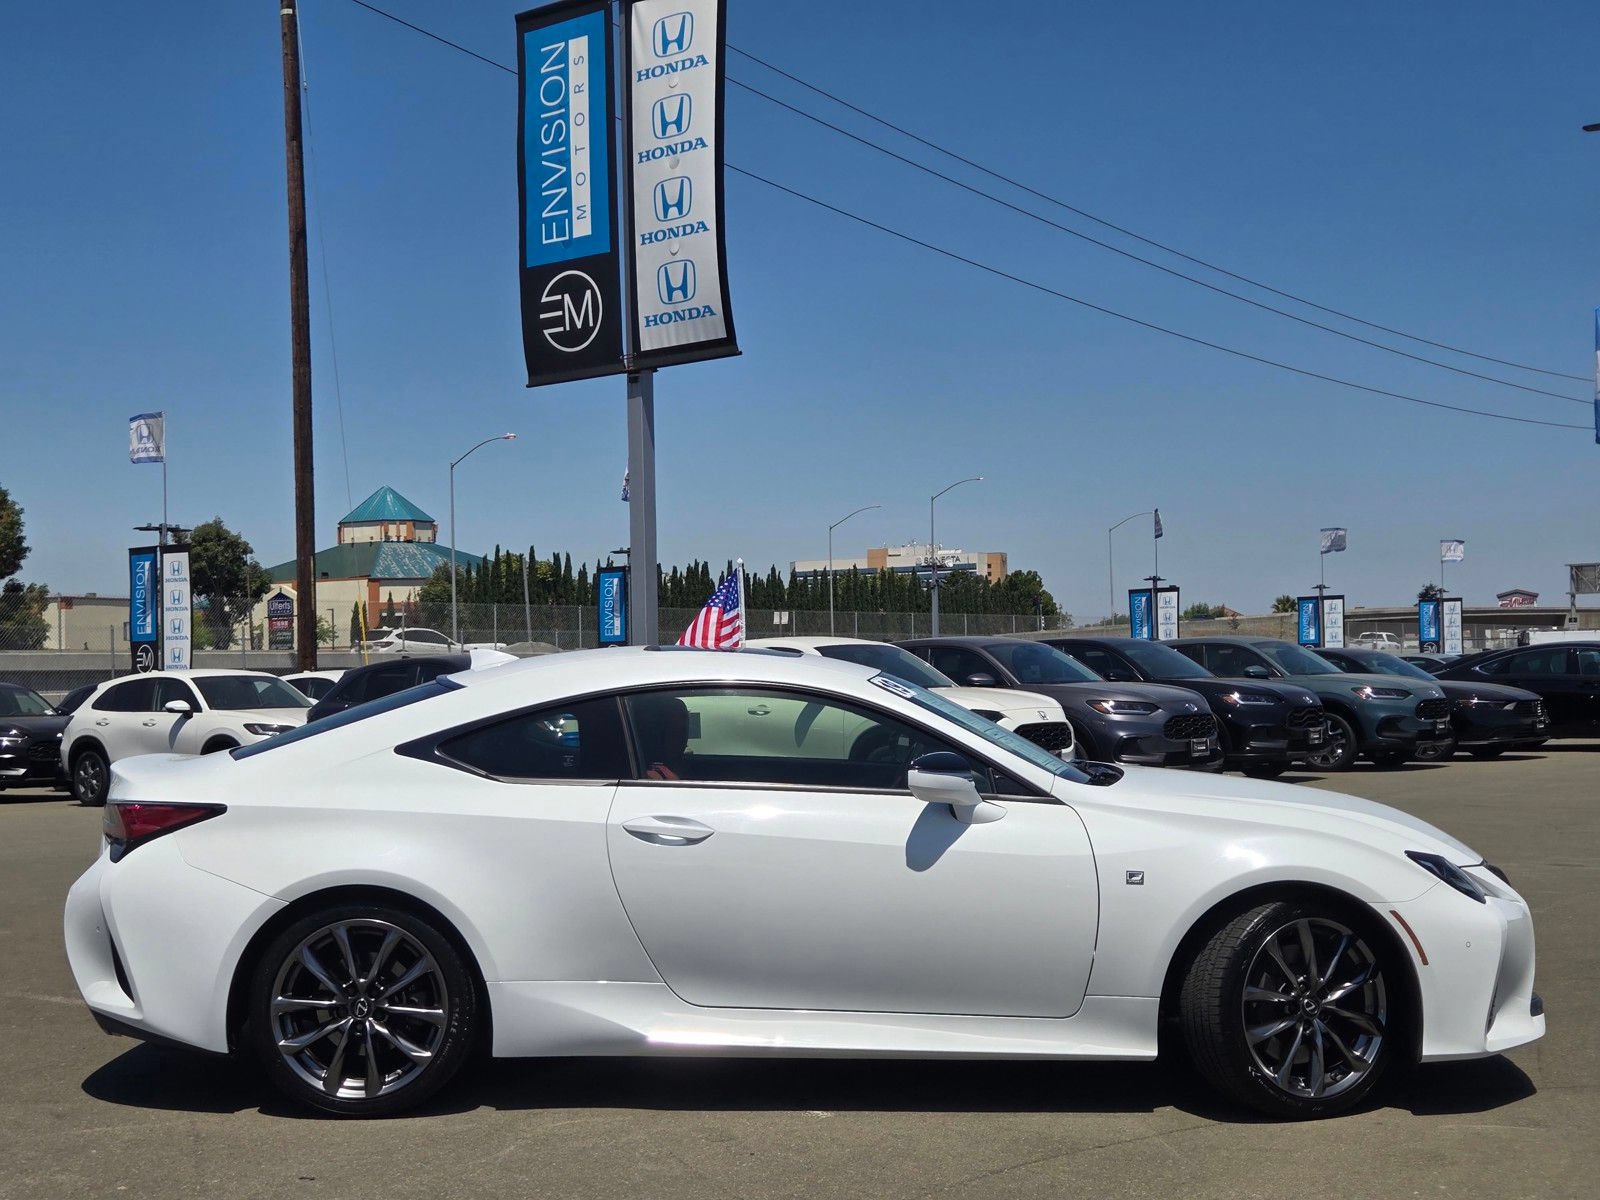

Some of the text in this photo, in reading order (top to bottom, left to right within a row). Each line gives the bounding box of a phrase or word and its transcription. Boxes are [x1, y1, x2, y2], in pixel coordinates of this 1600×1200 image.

[636, 54, 710, 83] HONDA
[540, 41, 569, 245] ENVISION
[573, 55, 587, 220] MOTORS
[637, 137, 709, 165] HONDA
[640, 220, 710, 246] HONDA
[644, 304, 717, 328] HONDA
[136, 561, 146, 635] ENVISION
[604, 578, 613, 636] ENVISION
